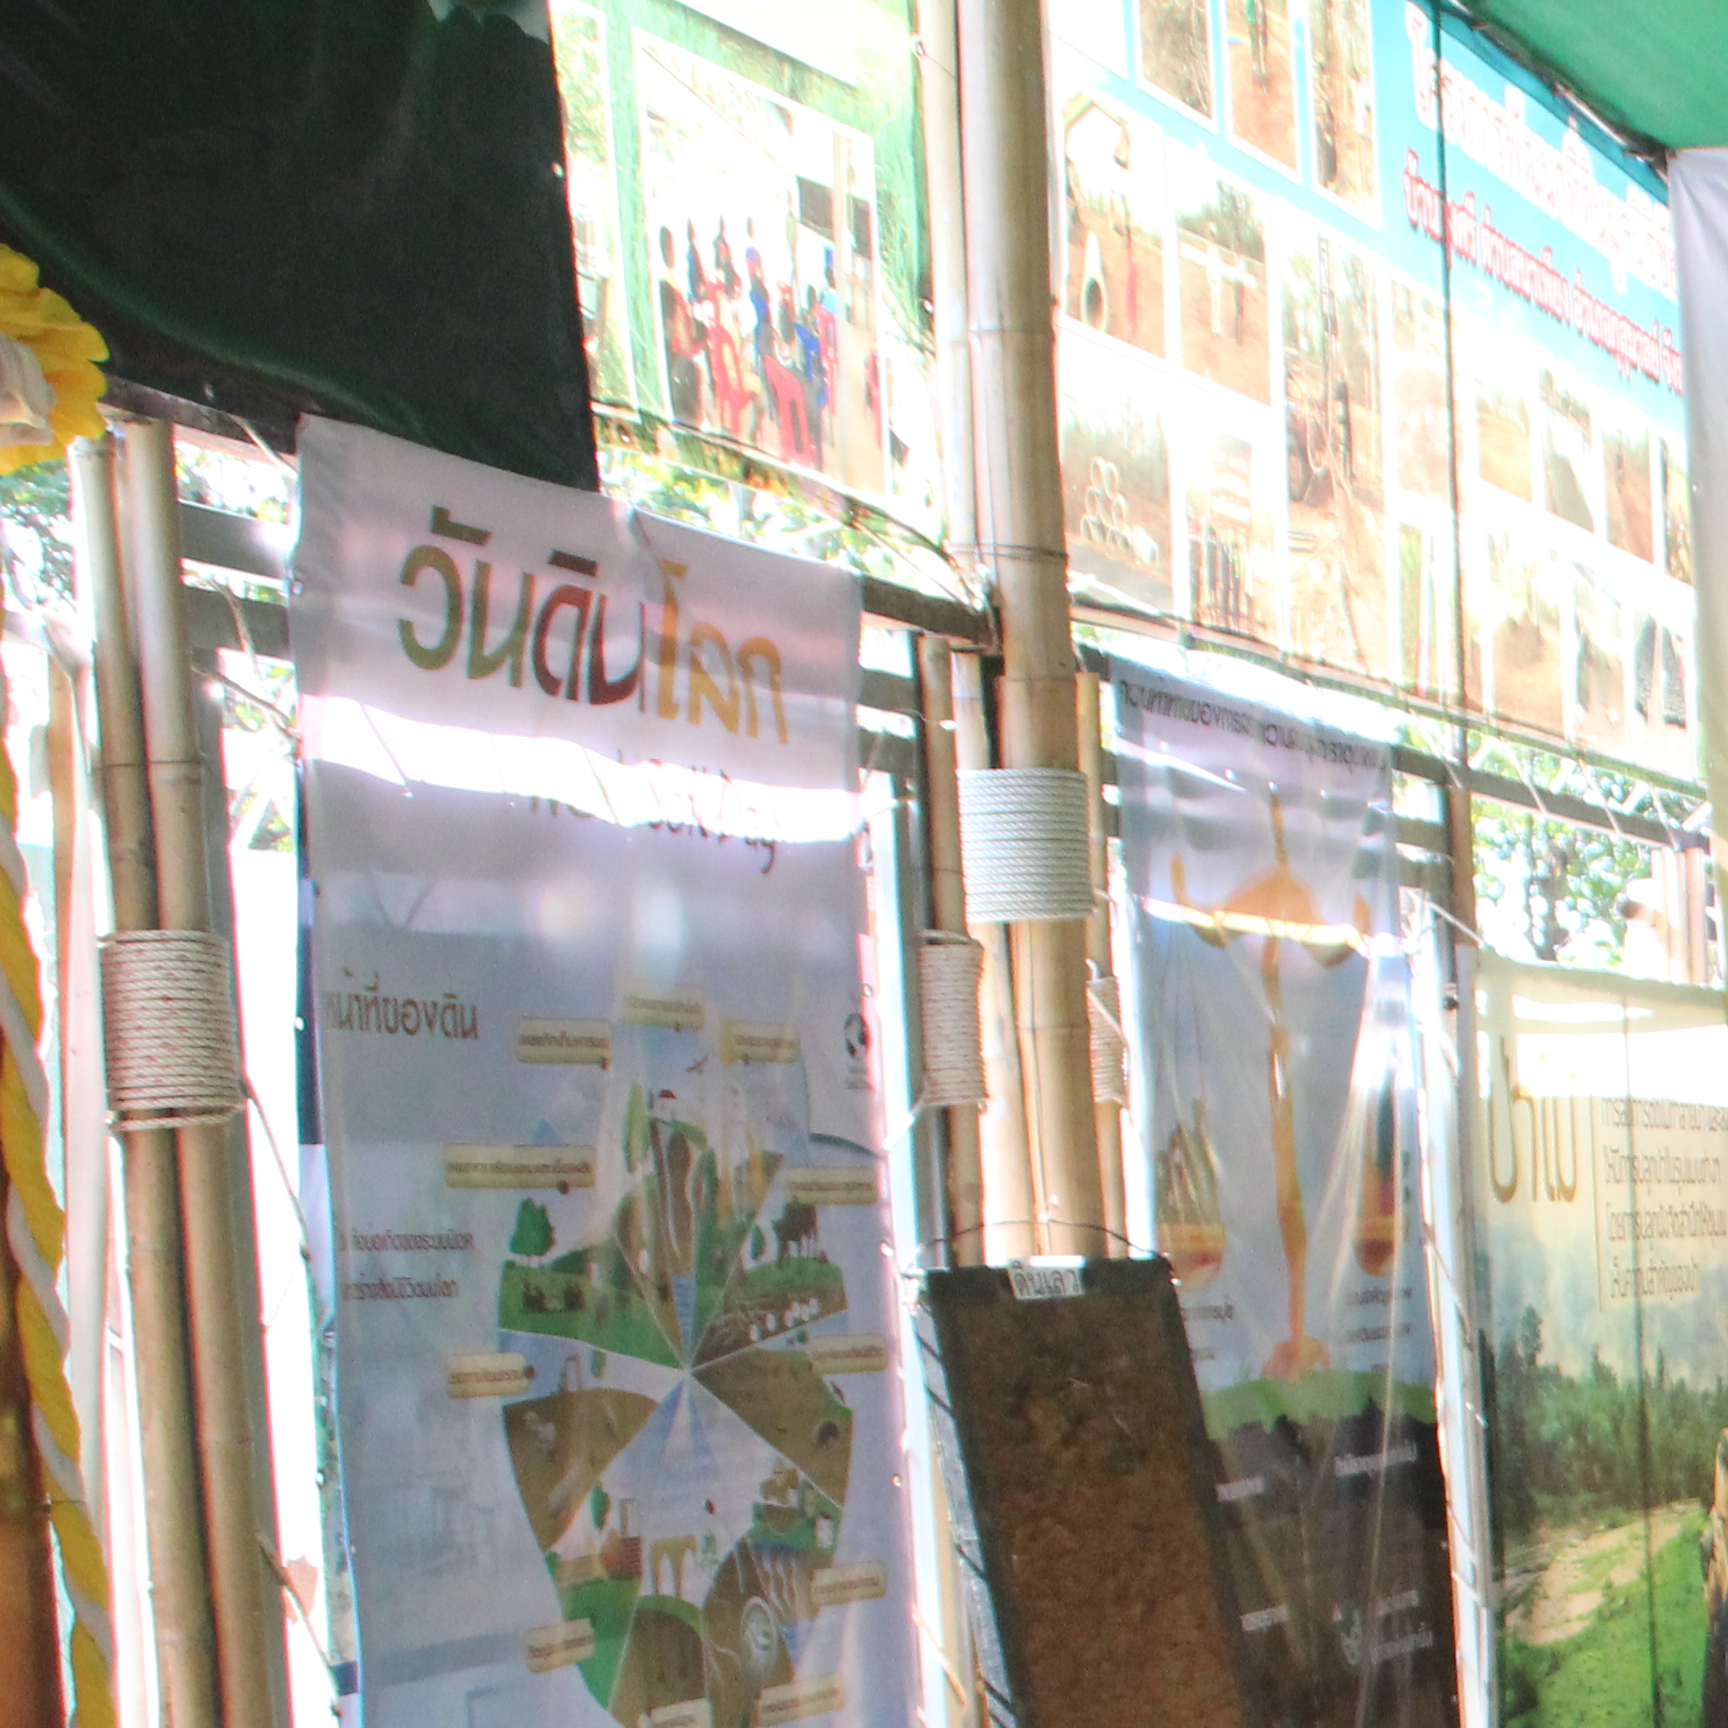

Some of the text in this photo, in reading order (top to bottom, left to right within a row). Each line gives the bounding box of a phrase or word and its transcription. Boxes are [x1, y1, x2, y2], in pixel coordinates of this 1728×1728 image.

[398, 505, 789, 745] วันดินโลก
[1012, 1260, 1079, 1296] ดินเลว
